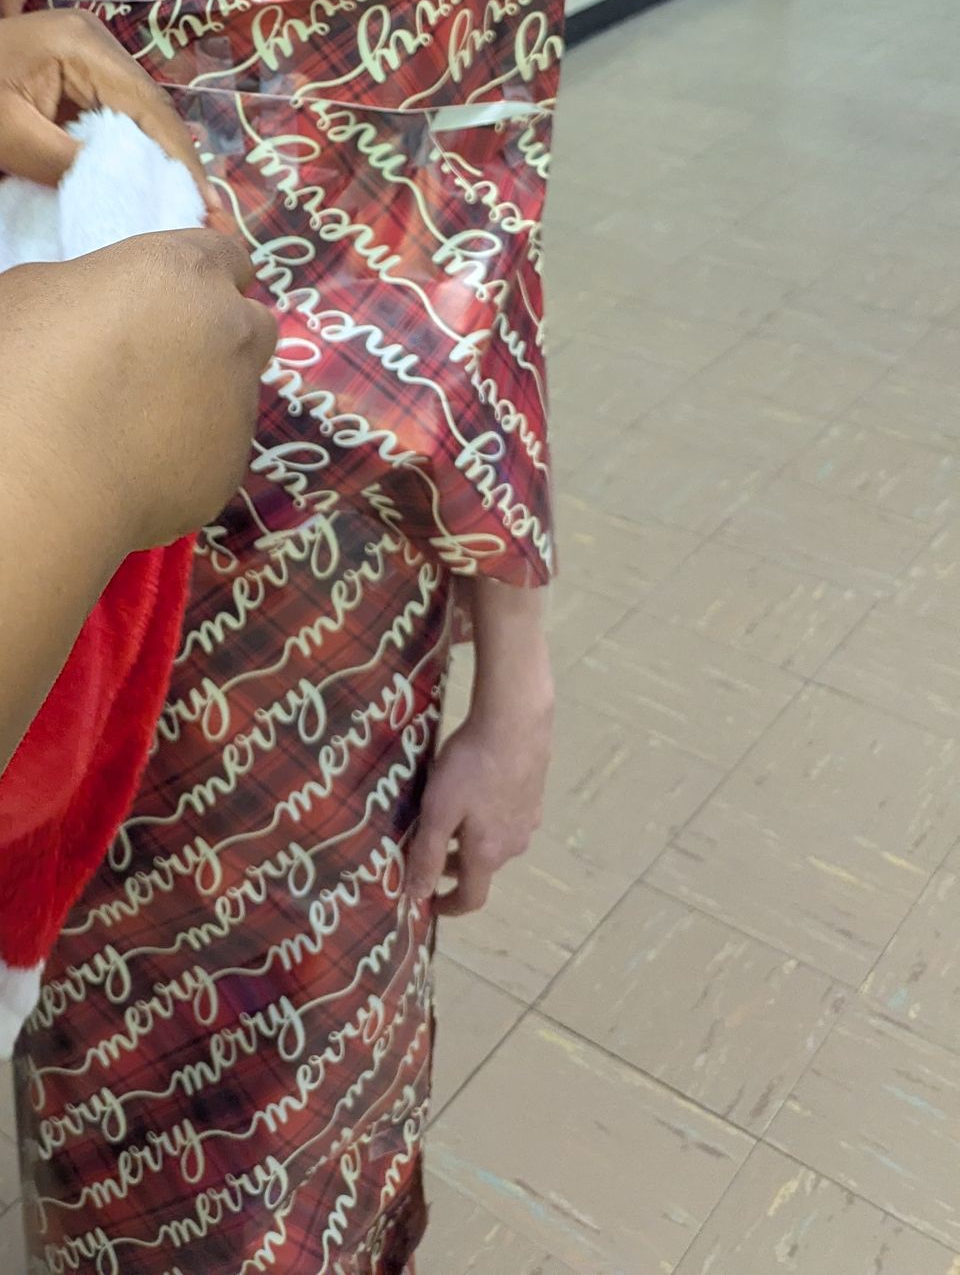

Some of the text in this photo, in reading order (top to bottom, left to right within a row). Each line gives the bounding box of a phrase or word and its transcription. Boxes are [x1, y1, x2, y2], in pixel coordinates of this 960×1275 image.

[178, 678, 326, 815] merry
[88, 836, 222, 927] merry
[176, 842, 315, 951] merry
[86, 965, 218, 1068] merry
[40, 1087, 126, 1160] erry
[172, 995, 305, 1096] merry
[83, 1118, 205, 1208] merry
[160, 1156, 289, 1247] merry
